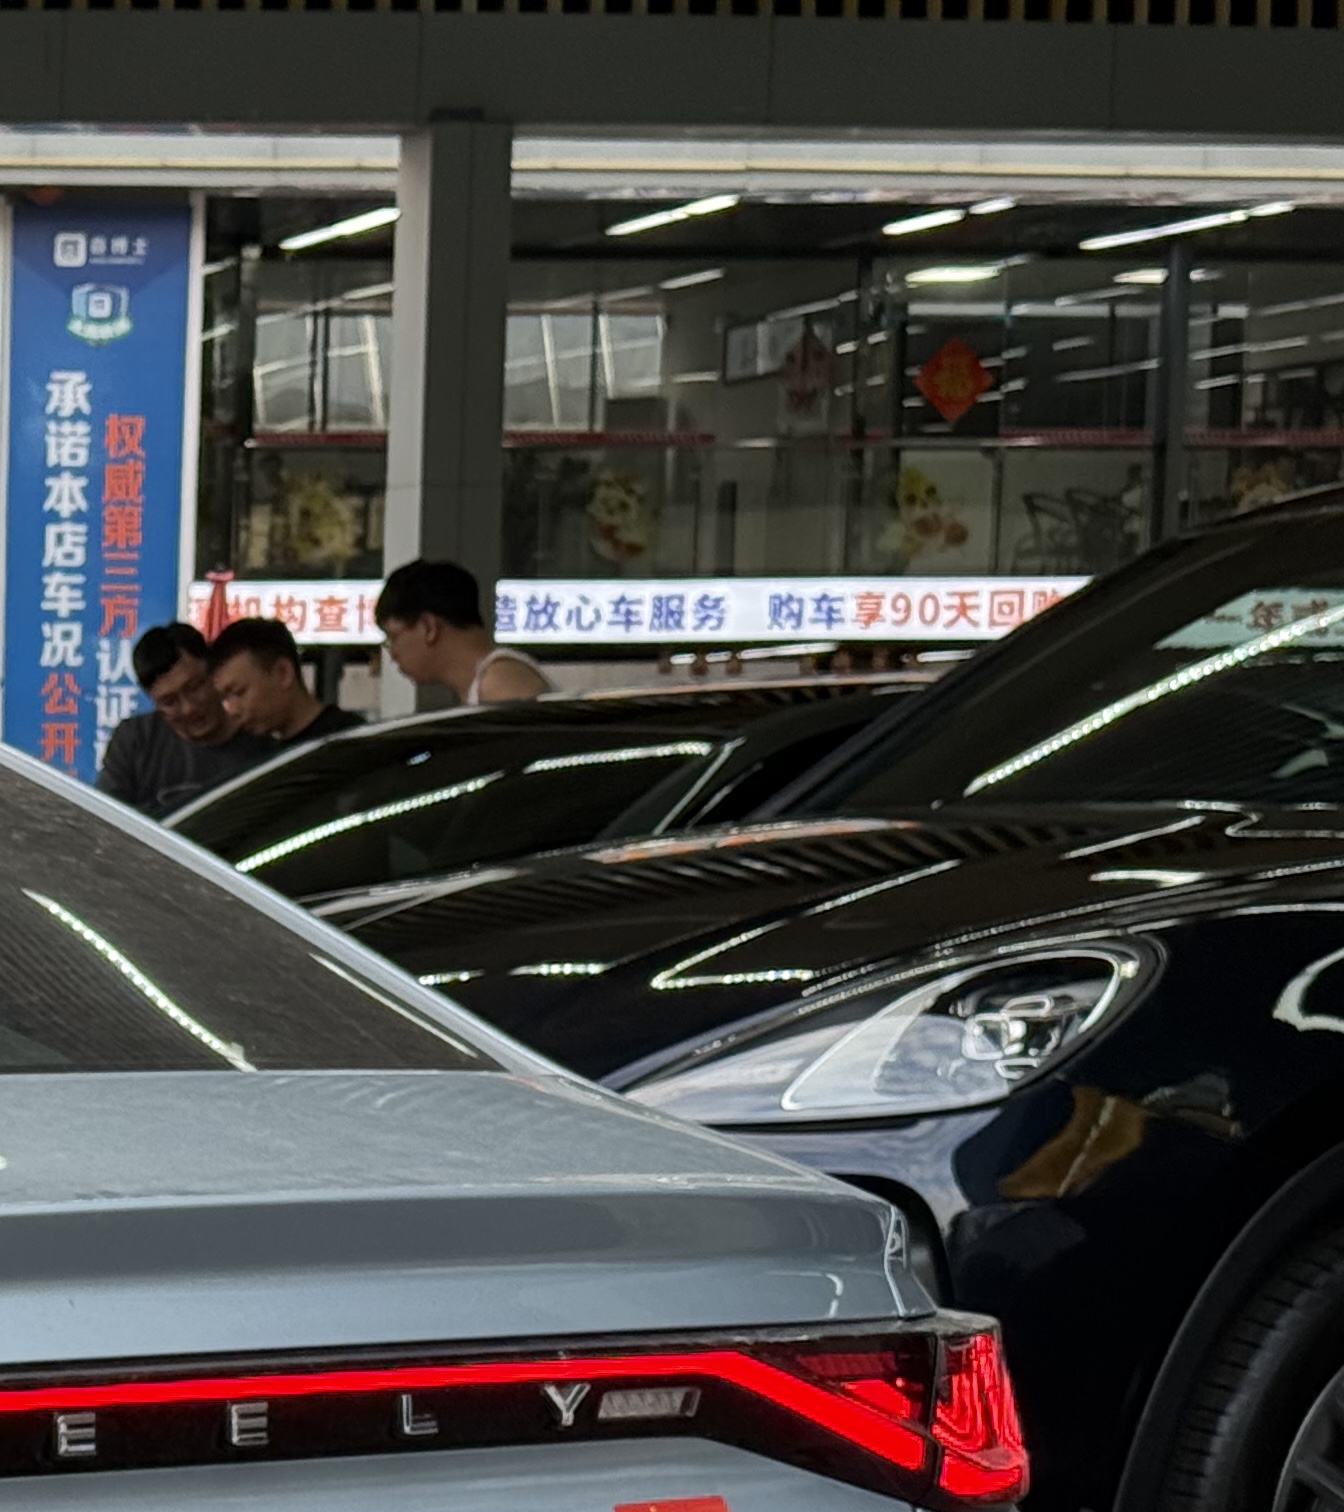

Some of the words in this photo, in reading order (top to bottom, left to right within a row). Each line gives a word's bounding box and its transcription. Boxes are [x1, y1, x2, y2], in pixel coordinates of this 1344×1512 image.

[39, 370, 92, 778] 承诺本店车况公开
